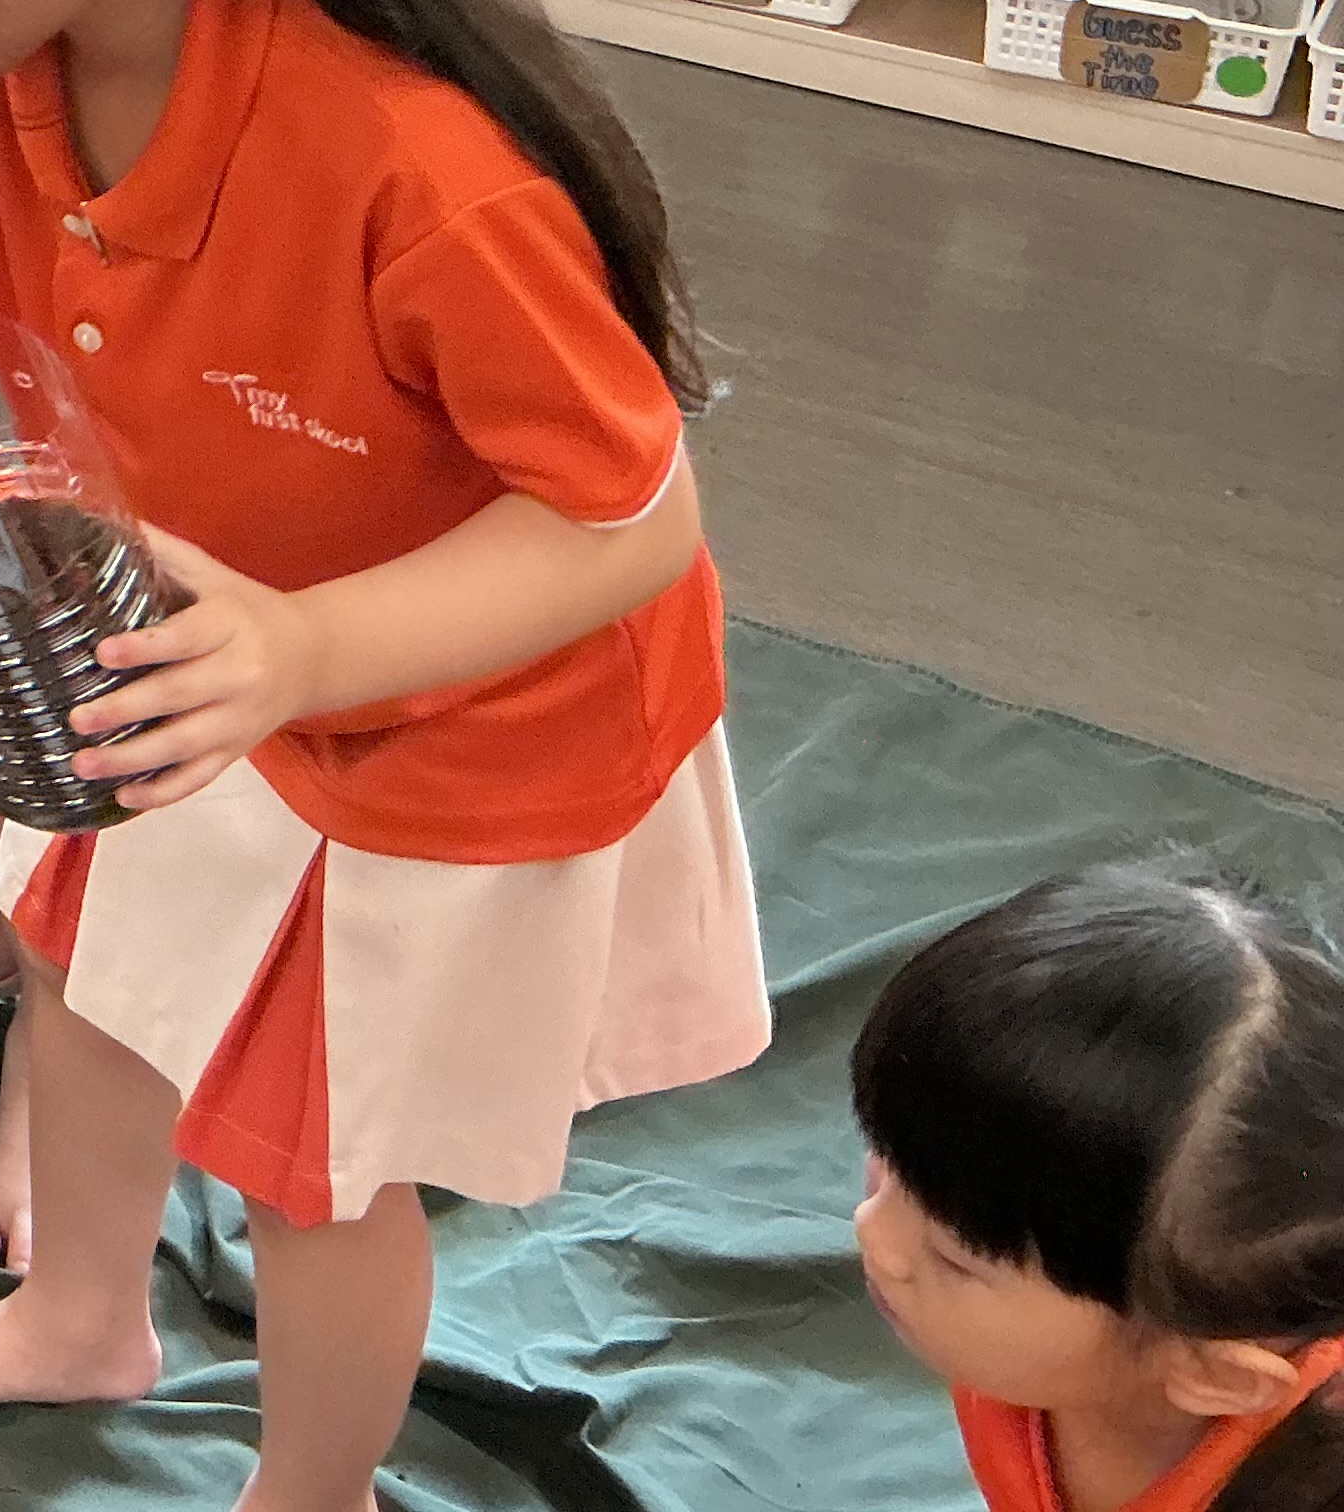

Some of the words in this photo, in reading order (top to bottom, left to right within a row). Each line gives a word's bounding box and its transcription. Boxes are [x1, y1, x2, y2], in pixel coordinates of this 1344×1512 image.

[1082, 4, 1183, 53] Guess
[1101, 43, 1155, 76] the
[1082, 60, 1161, 100] Time
